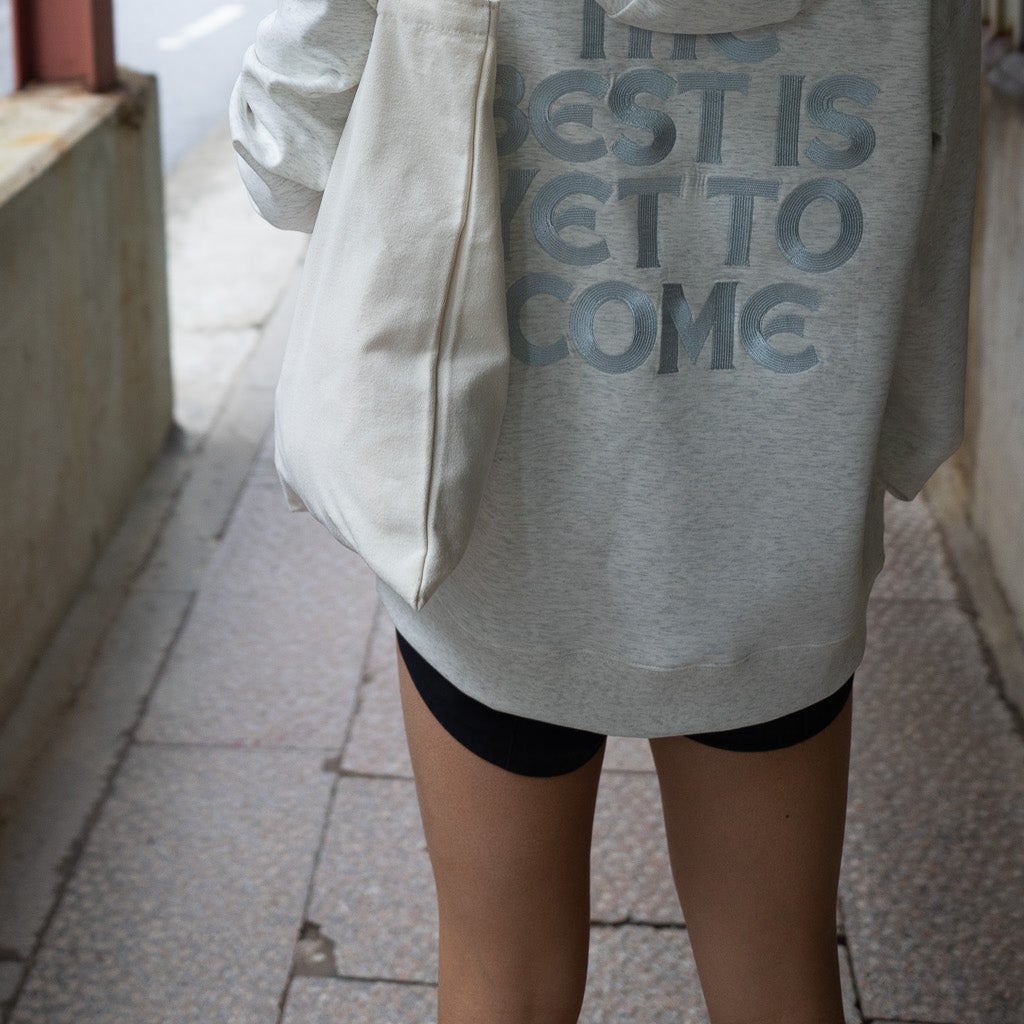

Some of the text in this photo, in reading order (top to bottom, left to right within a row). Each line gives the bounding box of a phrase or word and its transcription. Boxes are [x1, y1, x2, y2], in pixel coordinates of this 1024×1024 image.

[774, 74, 880, 169] IS
[706, 177, 863, 273] TO
[506, 276, 821, 374] COME
